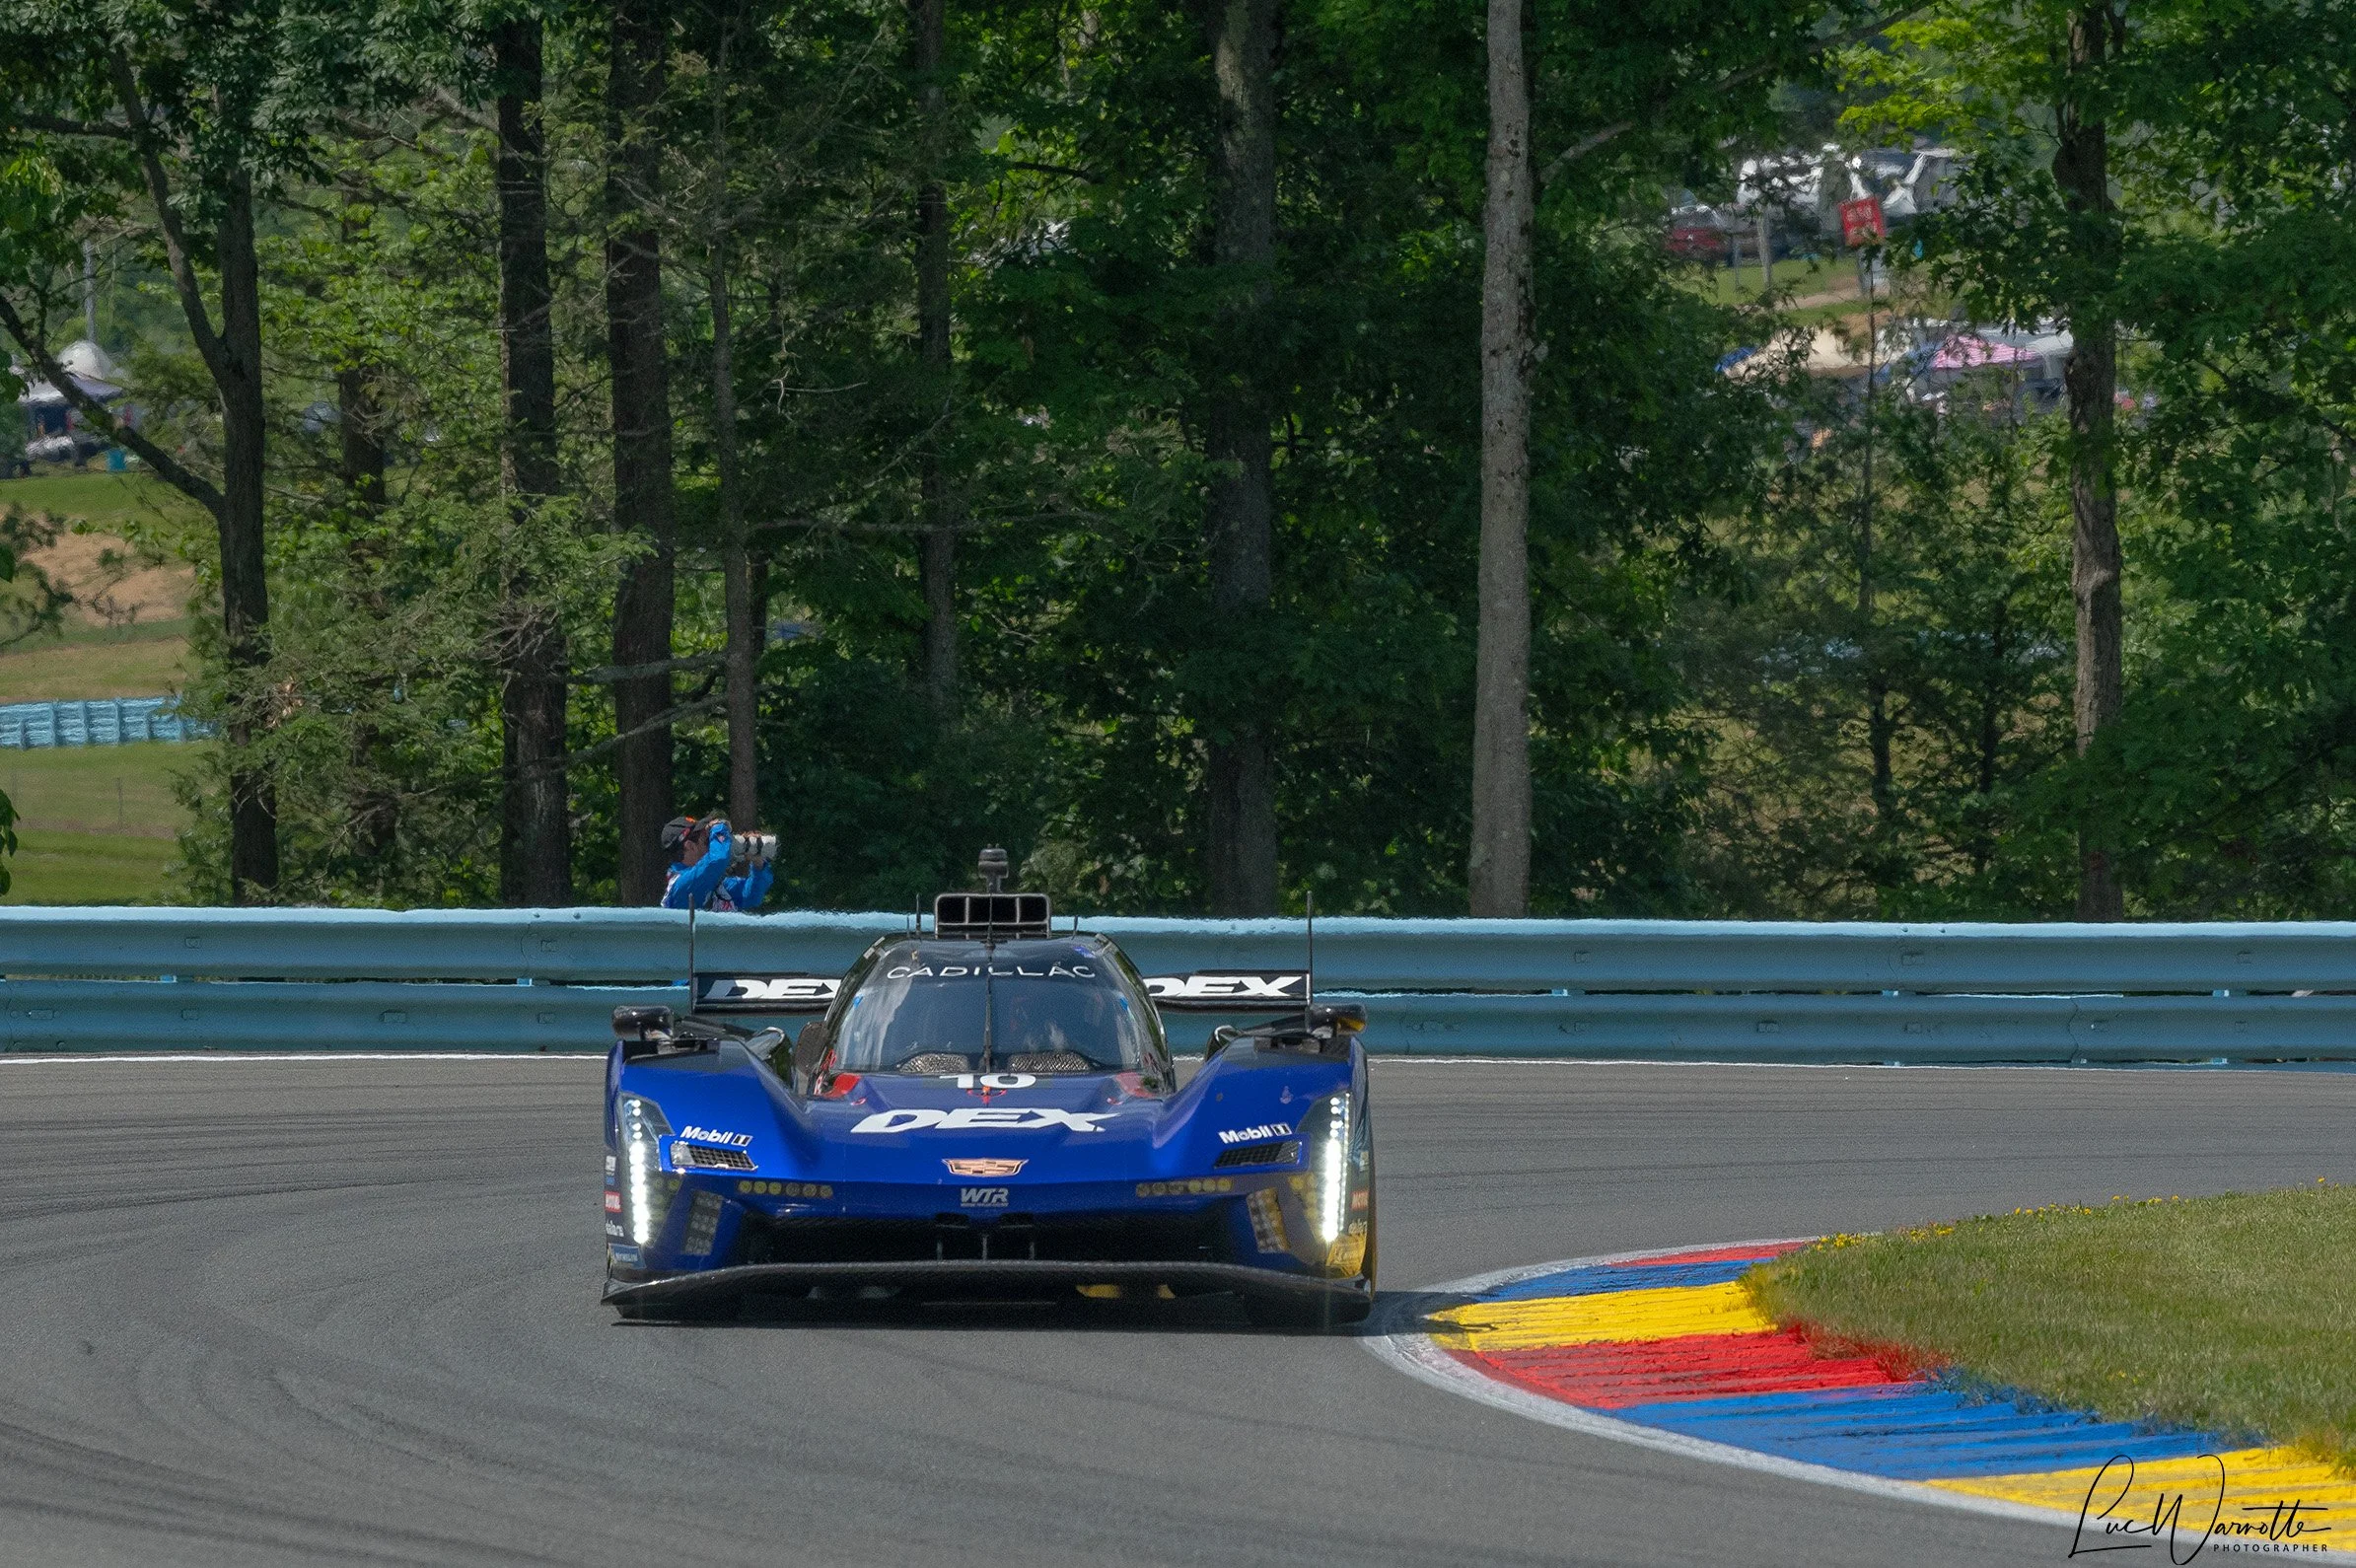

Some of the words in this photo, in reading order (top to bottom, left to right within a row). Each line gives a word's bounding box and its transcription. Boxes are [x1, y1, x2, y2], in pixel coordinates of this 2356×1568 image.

[887, 964, 1096, 980] CADILLAC
[939, 1073, 1036, 1089] 10
[850, 1107, 1120, 1133] DEX
[680, 1125, 734, 1144] Mobil
[731, 1133, 753, 1147] 1
[1218, 1124, 1273, 1144] Mobil
[1270, 1122, 1293, 1137] 1
[961, 1187, 1009, 1203] WTR
